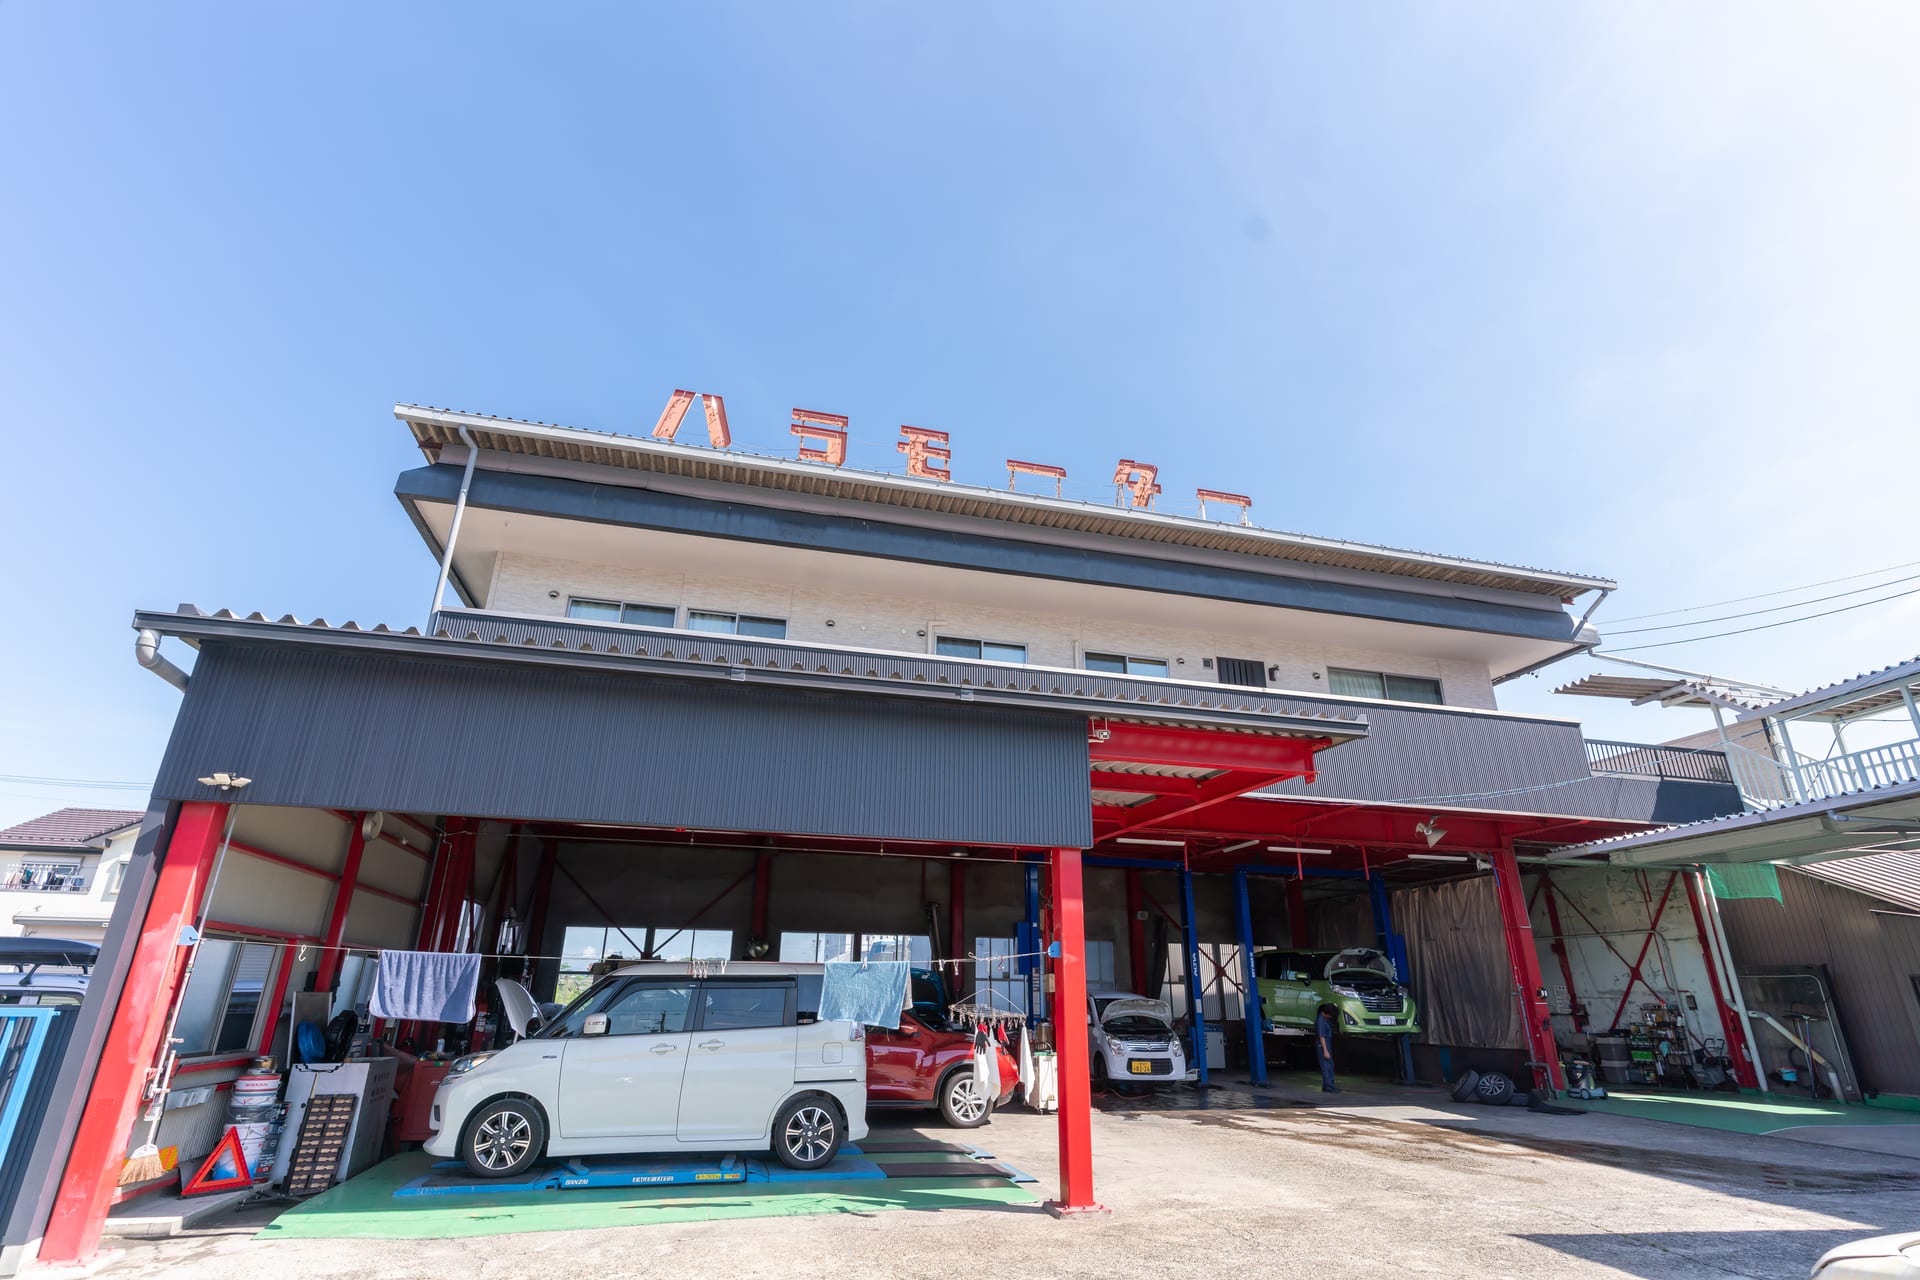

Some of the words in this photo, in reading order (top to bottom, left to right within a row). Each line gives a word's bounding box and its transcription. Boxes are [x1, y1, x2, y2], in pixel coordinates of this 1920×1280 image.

[651, 389, 1252, 508] ハラモーター
